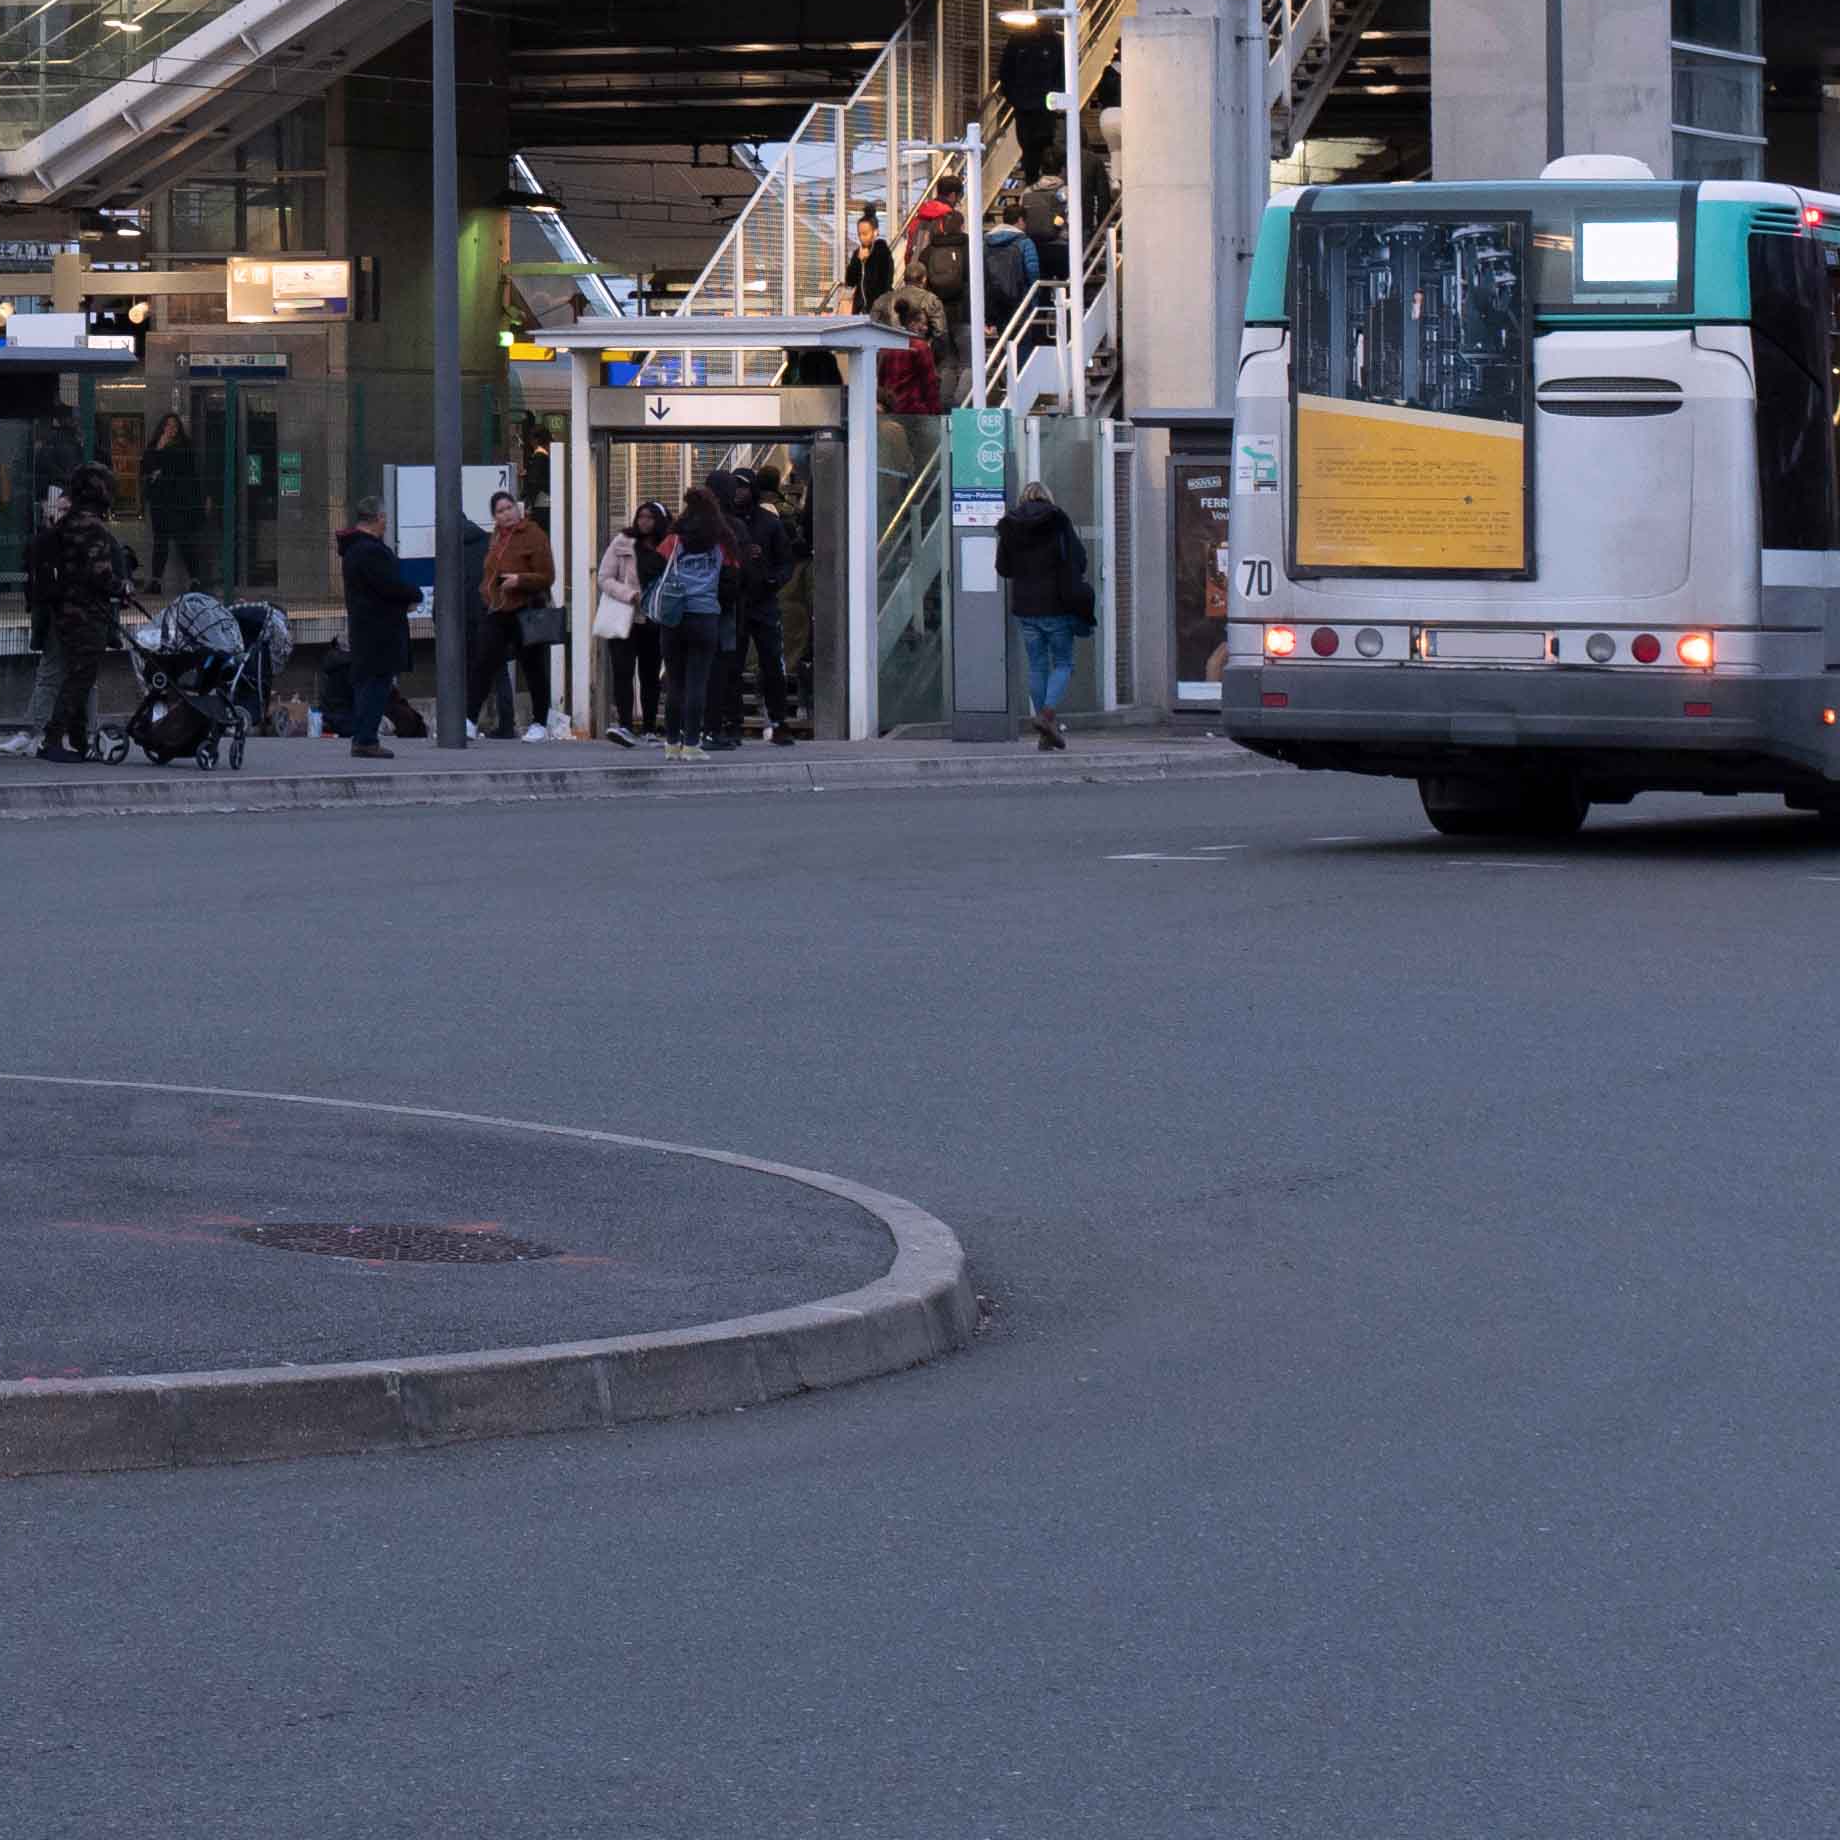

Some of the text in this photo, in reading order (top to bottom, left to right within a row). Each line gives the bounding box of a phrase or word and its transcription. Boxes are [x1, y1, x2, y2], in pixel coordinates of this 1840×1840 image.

[982, 415, 1002, 427] RER
[982, 452, 1004, 464] BUS
[1242, 560, 1272, 596] 70
